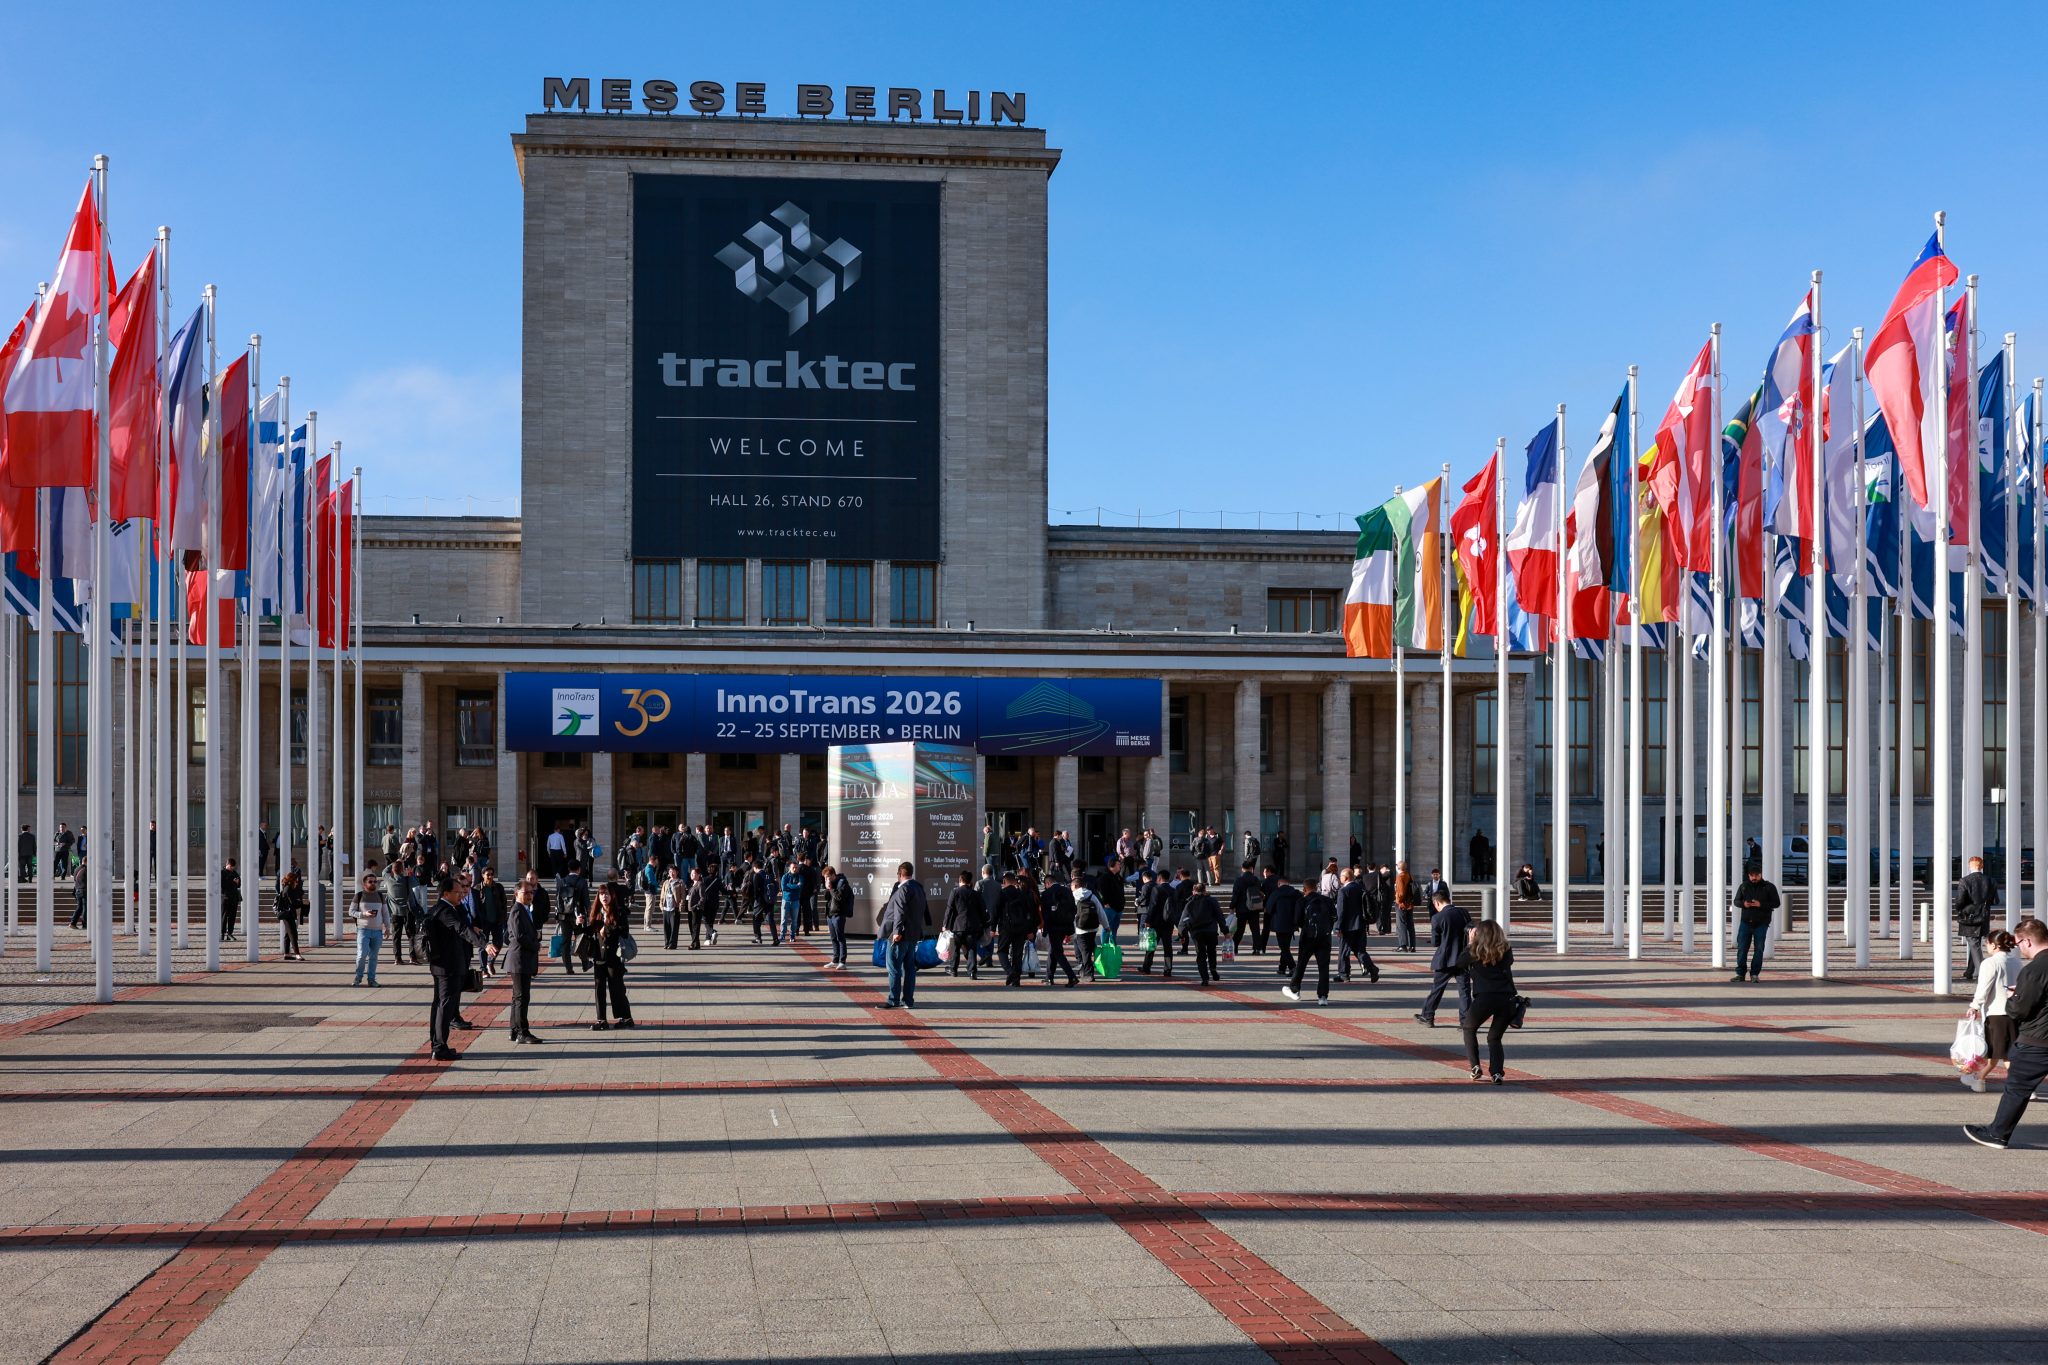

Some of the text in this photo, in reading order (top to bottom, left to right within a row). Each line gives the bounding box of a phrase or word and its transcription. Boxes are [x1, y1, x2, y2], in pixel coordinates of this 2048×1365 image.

[543, 77, 1026, 123] MESSE BERLIN
[657, 350, 916, 392] tracktec
[709, 437, 865, 457] WELCOME
[710, 494, 864, 509] HALL 26, STAND 670
[737, 527, 837, 538] www.tracktec.eu
[557, 691, 595, 701] InnoTrans
[717, 688, 961, 715] InnoTrans 2026
[614, 688, 672, 737] 30
[716, 722, 736, 738] 22
[754, 722, 774, 738] 25
[779, 722, 880, 739] SEPTEMBER
[901, 724, 961, 740] BERLIN
[844, 782, 899, 800] ITALIA
[927, 782, 968, 800] ITALIA
[847, 813, 894, 821] InnoTrans 2026
[929, 813, 964, 822] InnoTrans 2026
[859, 830, 881, 839] 22-25
[938, 830, 955, 840] 22-25
[882, 856, 901, 864] Agency
[956, 857, 968, 865] Agency
[930, 887, 942, 896] 10.1
